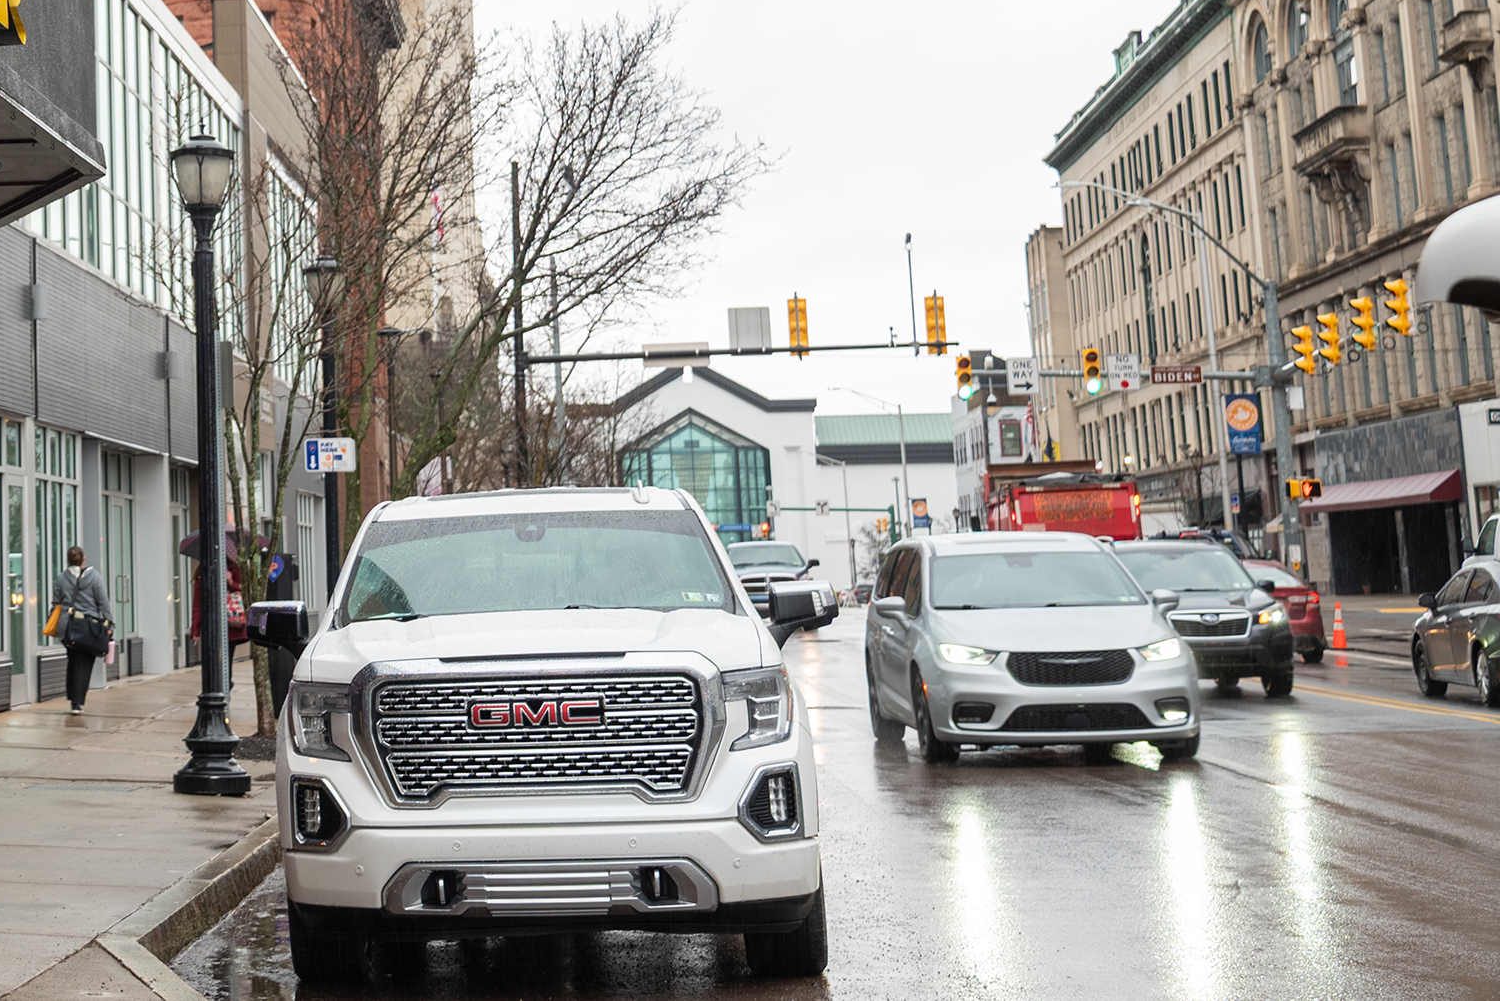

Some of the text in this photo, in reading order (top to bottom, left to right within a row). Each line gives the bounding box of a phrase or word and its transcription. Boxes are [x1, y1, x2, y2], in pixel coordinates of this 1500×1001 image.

[1116, 355, 1129, 363] NO
[1012, 360, 1032, 369] ONE
[1012, 370, 1033, 379] WAY
[1154, 372, 1192, 382] BIDEN
[471, 700, 601, 727] GMC
